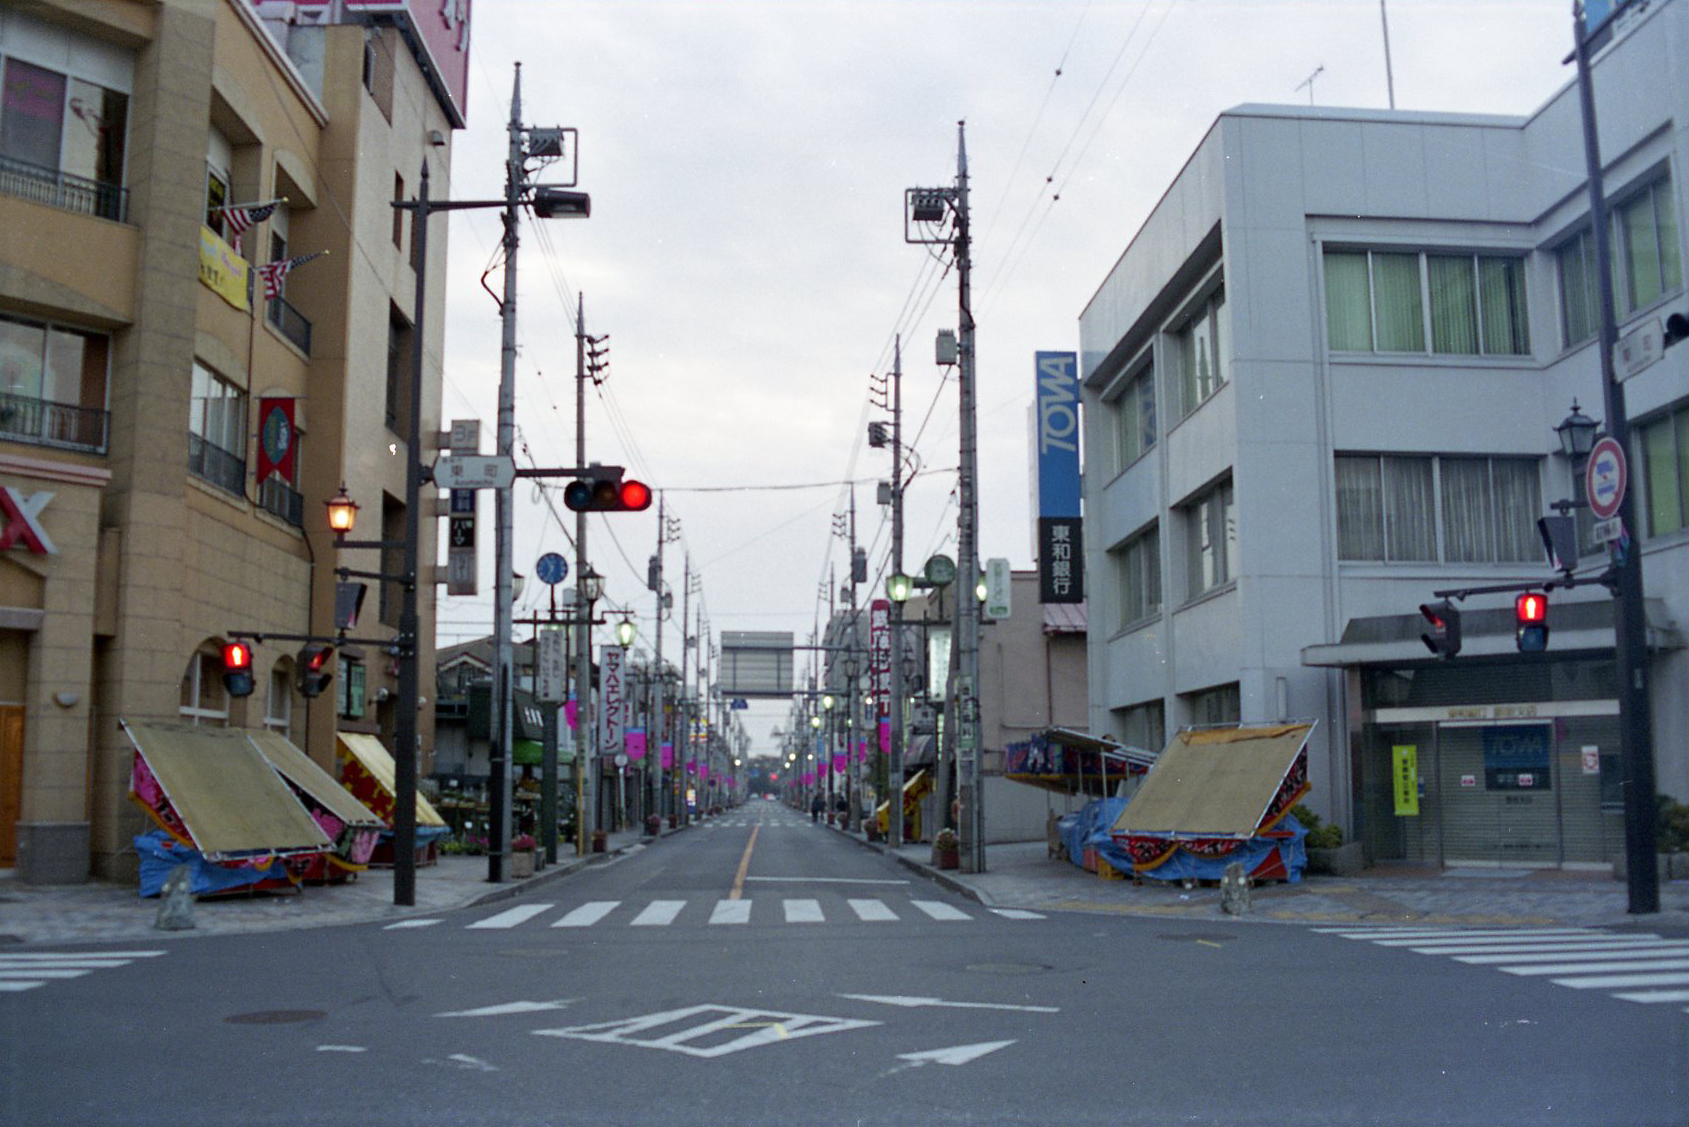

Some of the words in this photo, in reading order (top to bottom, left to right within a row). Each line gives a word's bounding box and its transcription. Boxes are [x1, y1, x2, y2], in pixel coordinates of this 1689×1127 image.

[1039, 356, 1076, 455] TOWA
[1051, 525, 1072, 595] 東和銀行
[604, 651, 620, 751] ヤマハエレクトーン
